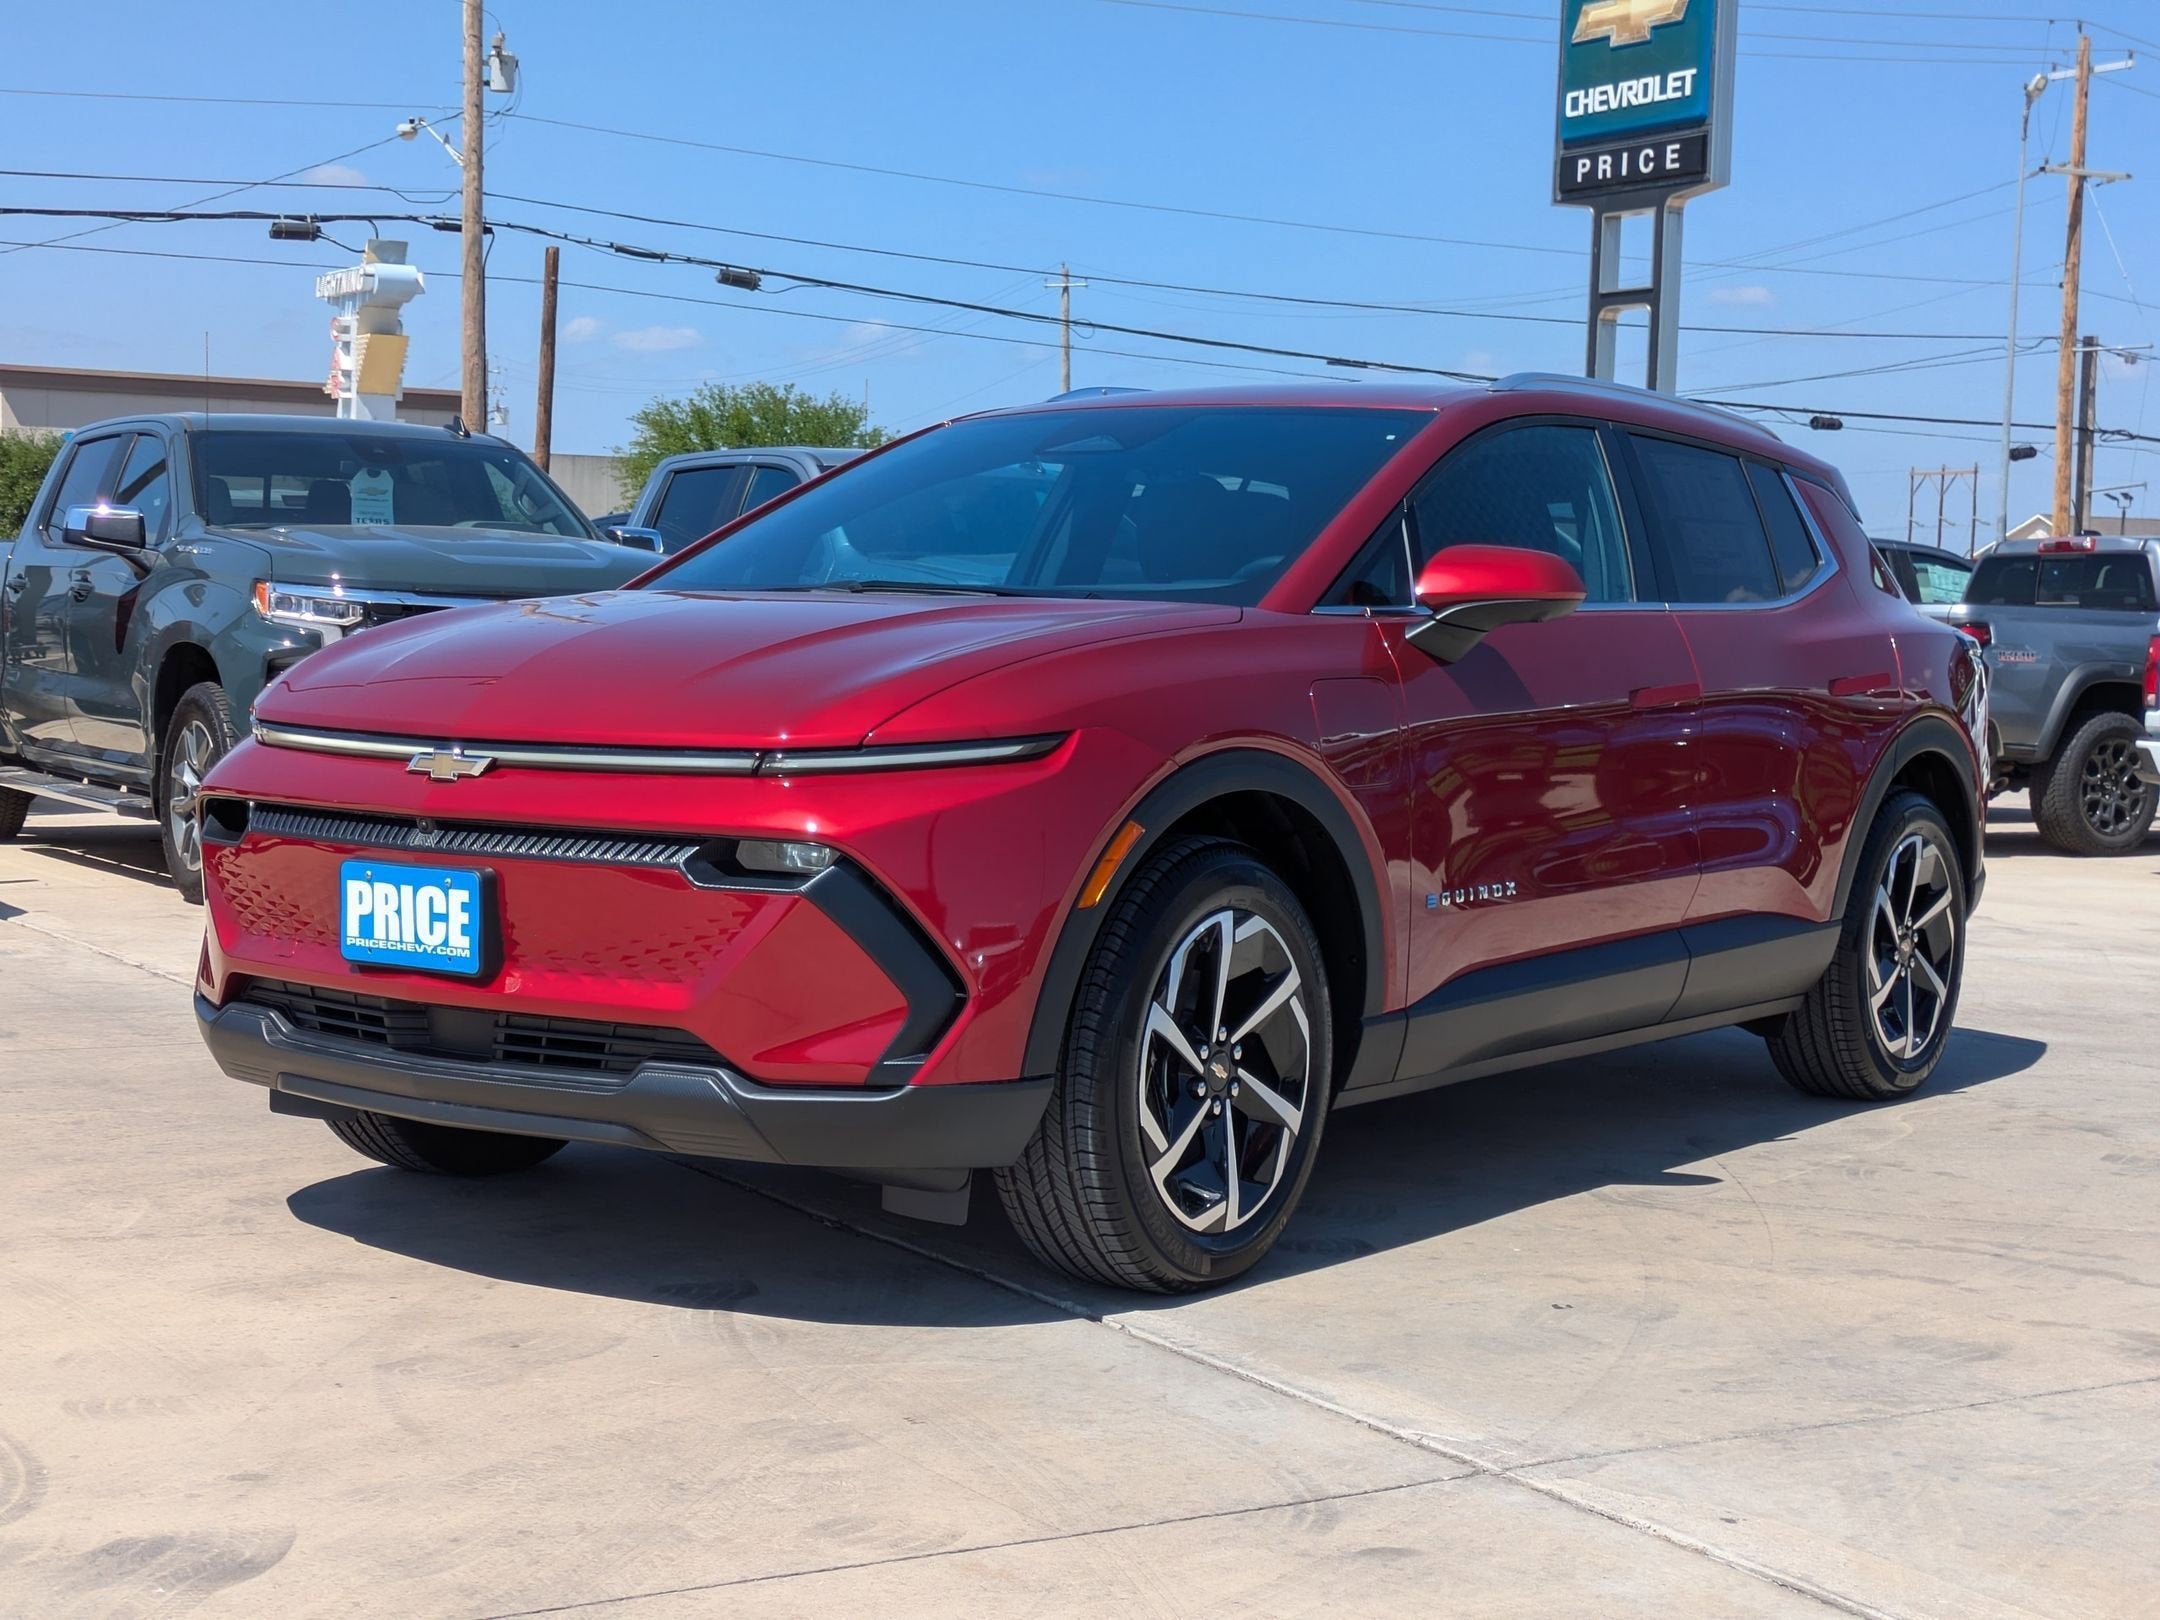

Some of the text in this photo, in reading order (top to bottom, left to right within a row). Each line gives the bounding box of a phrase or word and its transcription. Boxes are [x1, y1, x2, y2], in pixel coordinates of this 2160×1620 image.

[1565, 68, 1697, 118] CHEVROLET
[1576, 144, 1681, 183] PRICE
[346, 879, 470, 949] PRICE
[1426, 881, 1517, 909] EQUINOX
[346, 937, 470, 958] PRICECHEVY.COM
